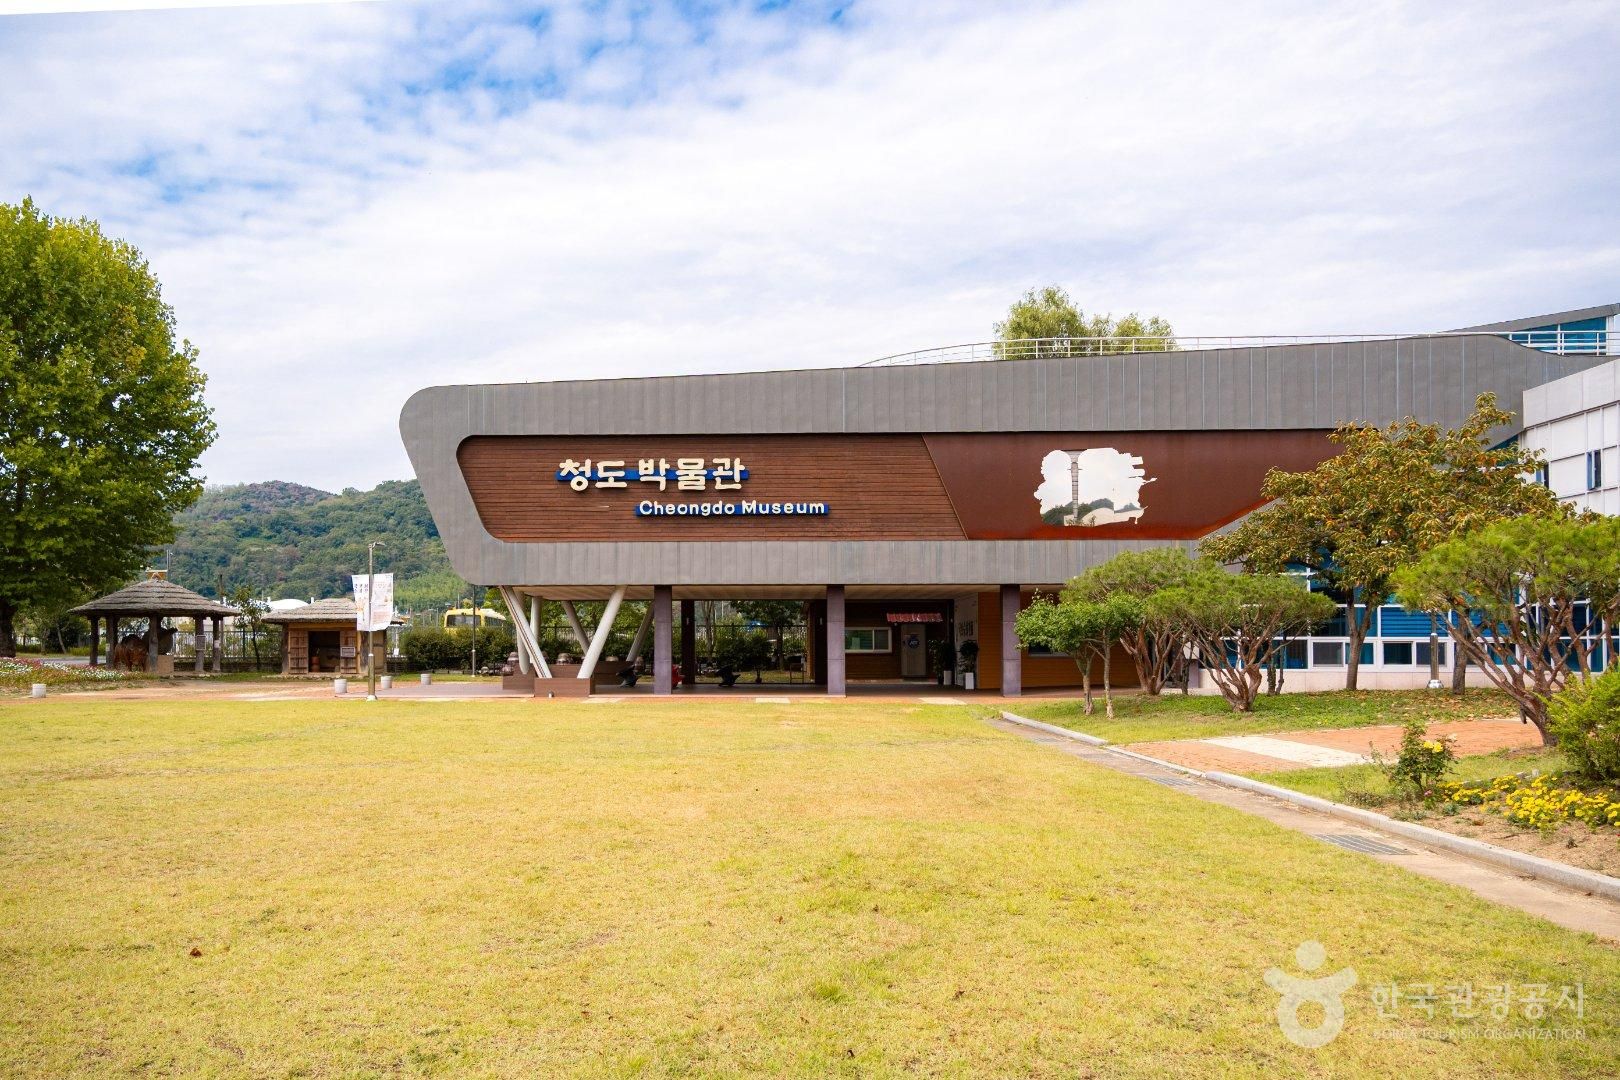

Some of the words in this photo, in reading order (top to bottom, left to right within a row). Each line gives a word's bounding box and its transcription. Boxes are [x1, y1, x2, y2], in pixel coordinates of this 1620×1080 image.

[559, 458, 627, 491] 청도
[638, 458, 746, 491] 박물관
[639, 500, 735, 516] Cheongdo
[742, 500, 825, 515] Museum
